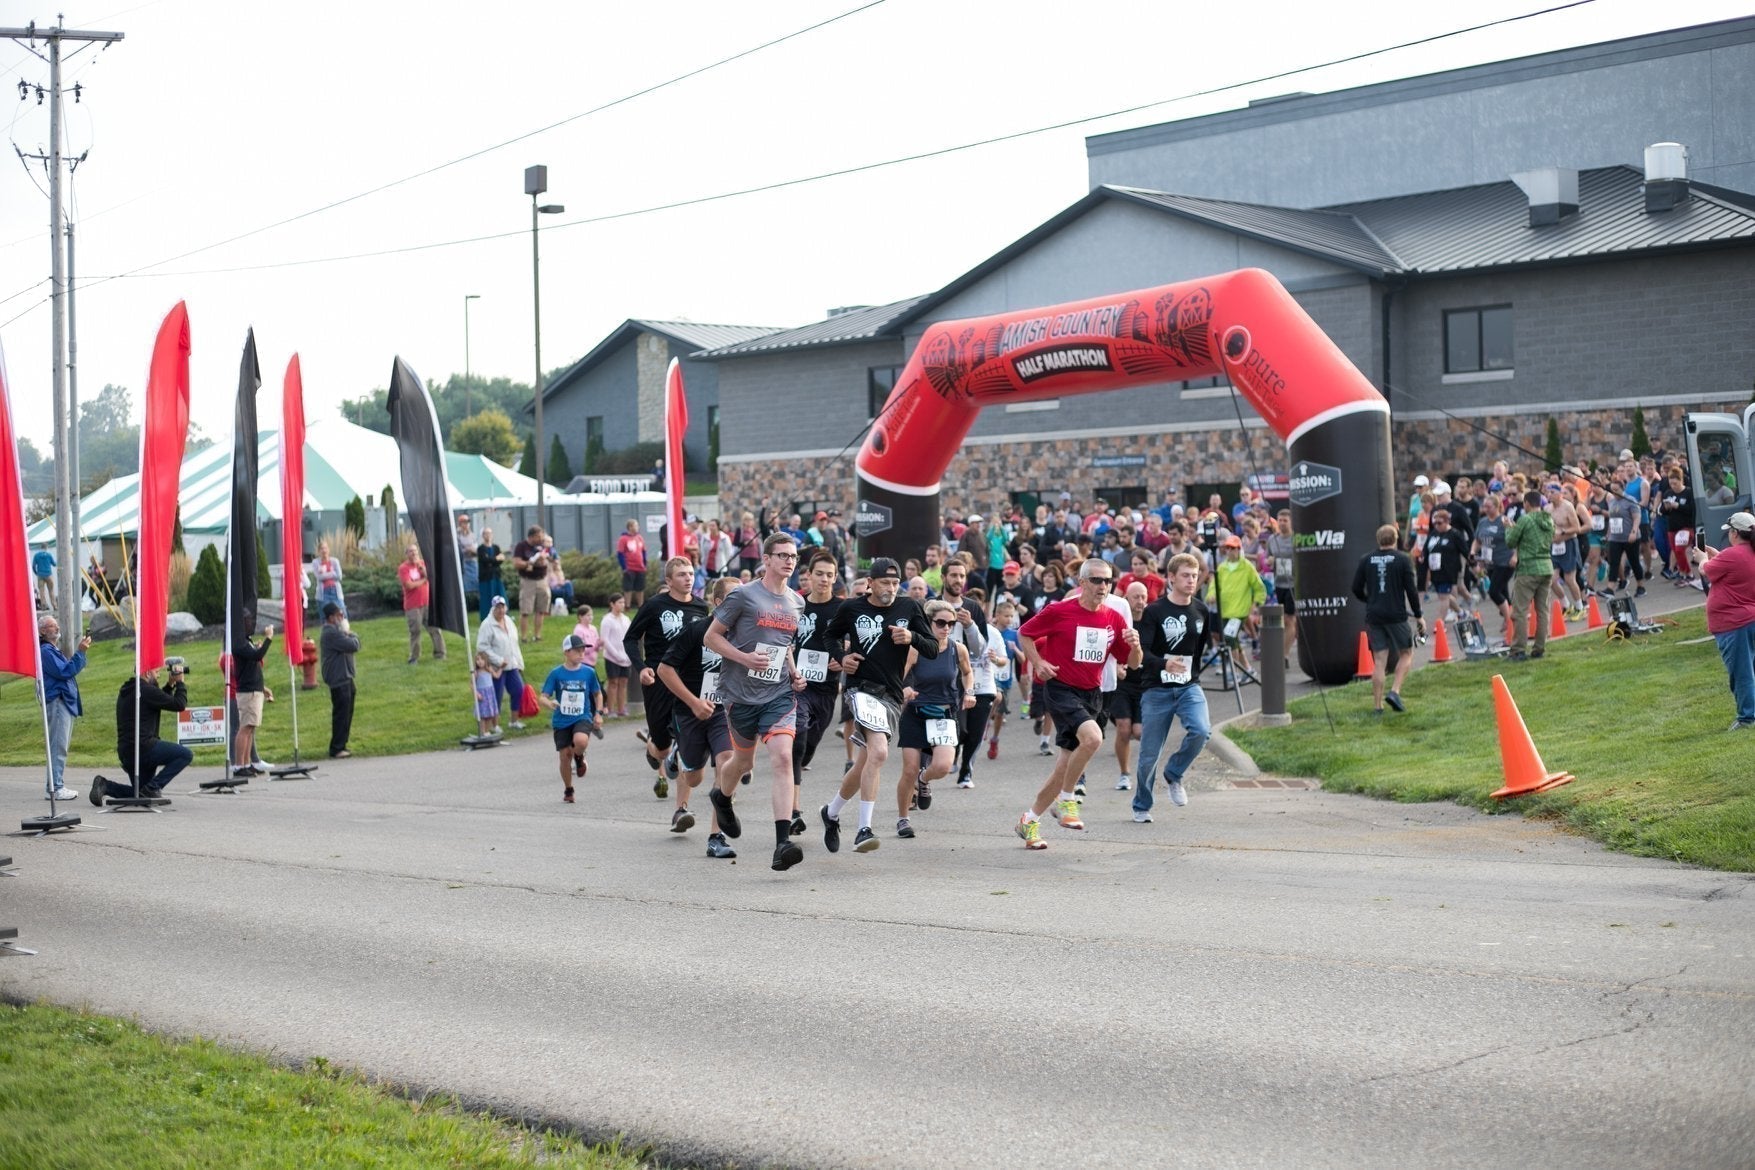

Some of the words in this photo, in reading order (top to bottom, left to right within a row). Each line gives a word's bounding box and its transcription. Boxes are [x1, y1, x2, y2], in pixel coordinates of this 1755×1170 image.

[1000, 317, 1052, 356] AMISH
[1051, 305, 1126, 338] COUNTRY
[1016, 355, 1045, 378] HALF
[1043, 349, 1108, 370] MARATHON
[1243, 349, 1285, 396] pure
[590, 479, 621, 493] FOOD
[622, 478, 651, 492] TENT
[1309, 597, 1348, 608] VALLEY
[757, 611, 797, 622] UNDER
[1079, 649, 1103, 661] 1008
[753, 669, 779, 680] 1097
[800, 668, 824, 681] 1020
[704, 692, 723, 702] 106
[862, 711, 885, 726] 1019
[931, 736, 955, 746] 1175
